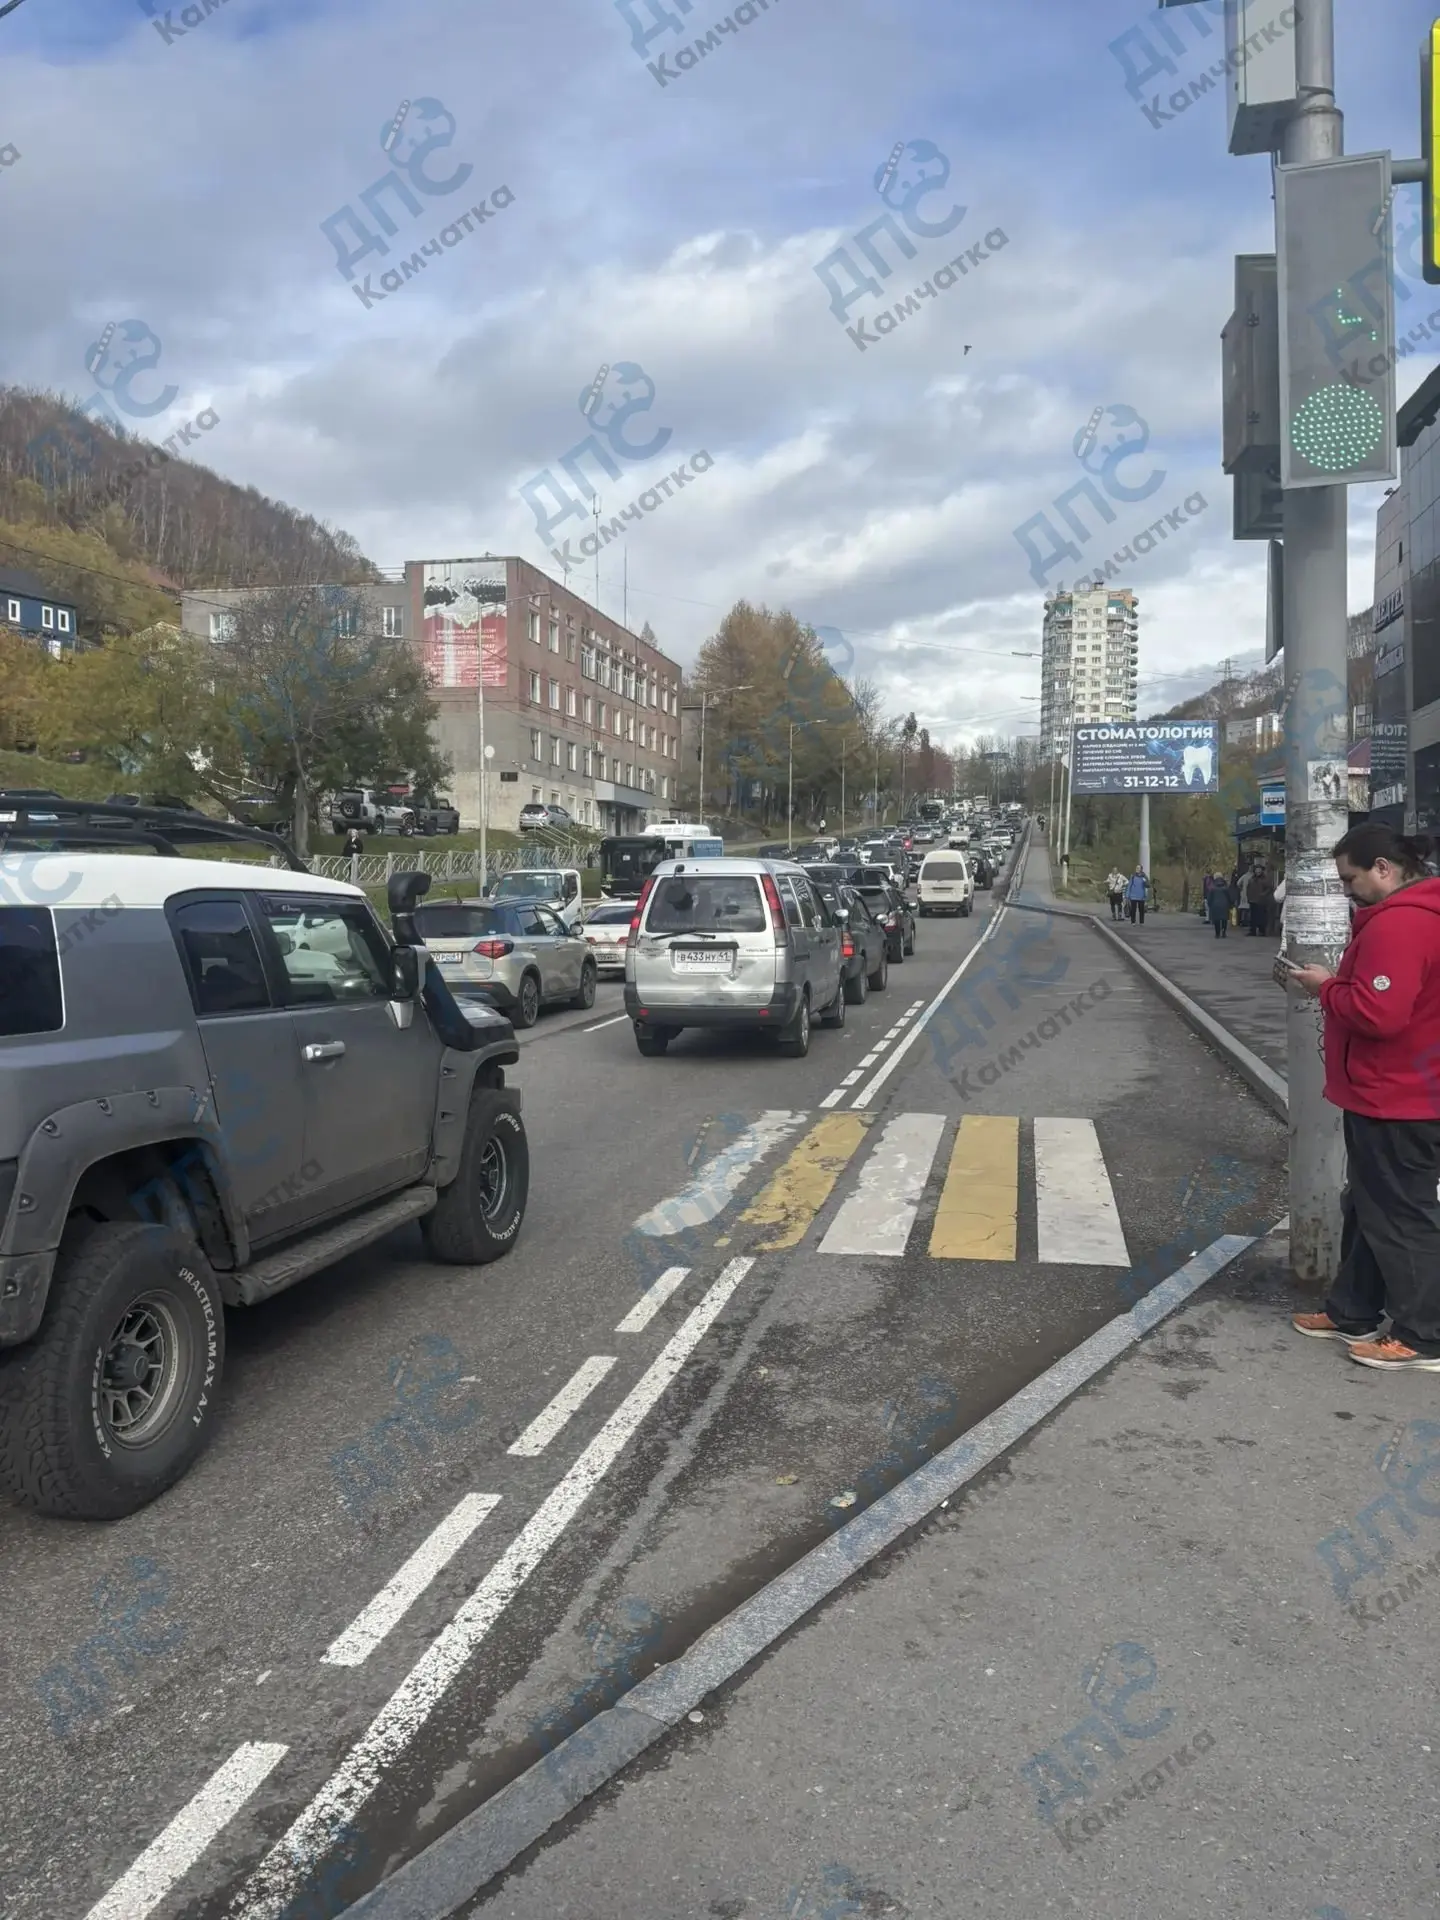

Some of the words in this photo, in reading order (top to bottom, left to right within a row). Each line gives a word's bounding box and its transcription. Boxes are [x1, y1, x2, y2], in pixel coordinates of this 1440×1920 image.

[1077, 726, 1213, 741] СТОМАТОЛОГИЯ
[1124, 775, 1179, 788] 31-12-12
[178, 1267, 217, 1387] PRACTICALMAX
[192, 1392, 208, 1427] A/T
